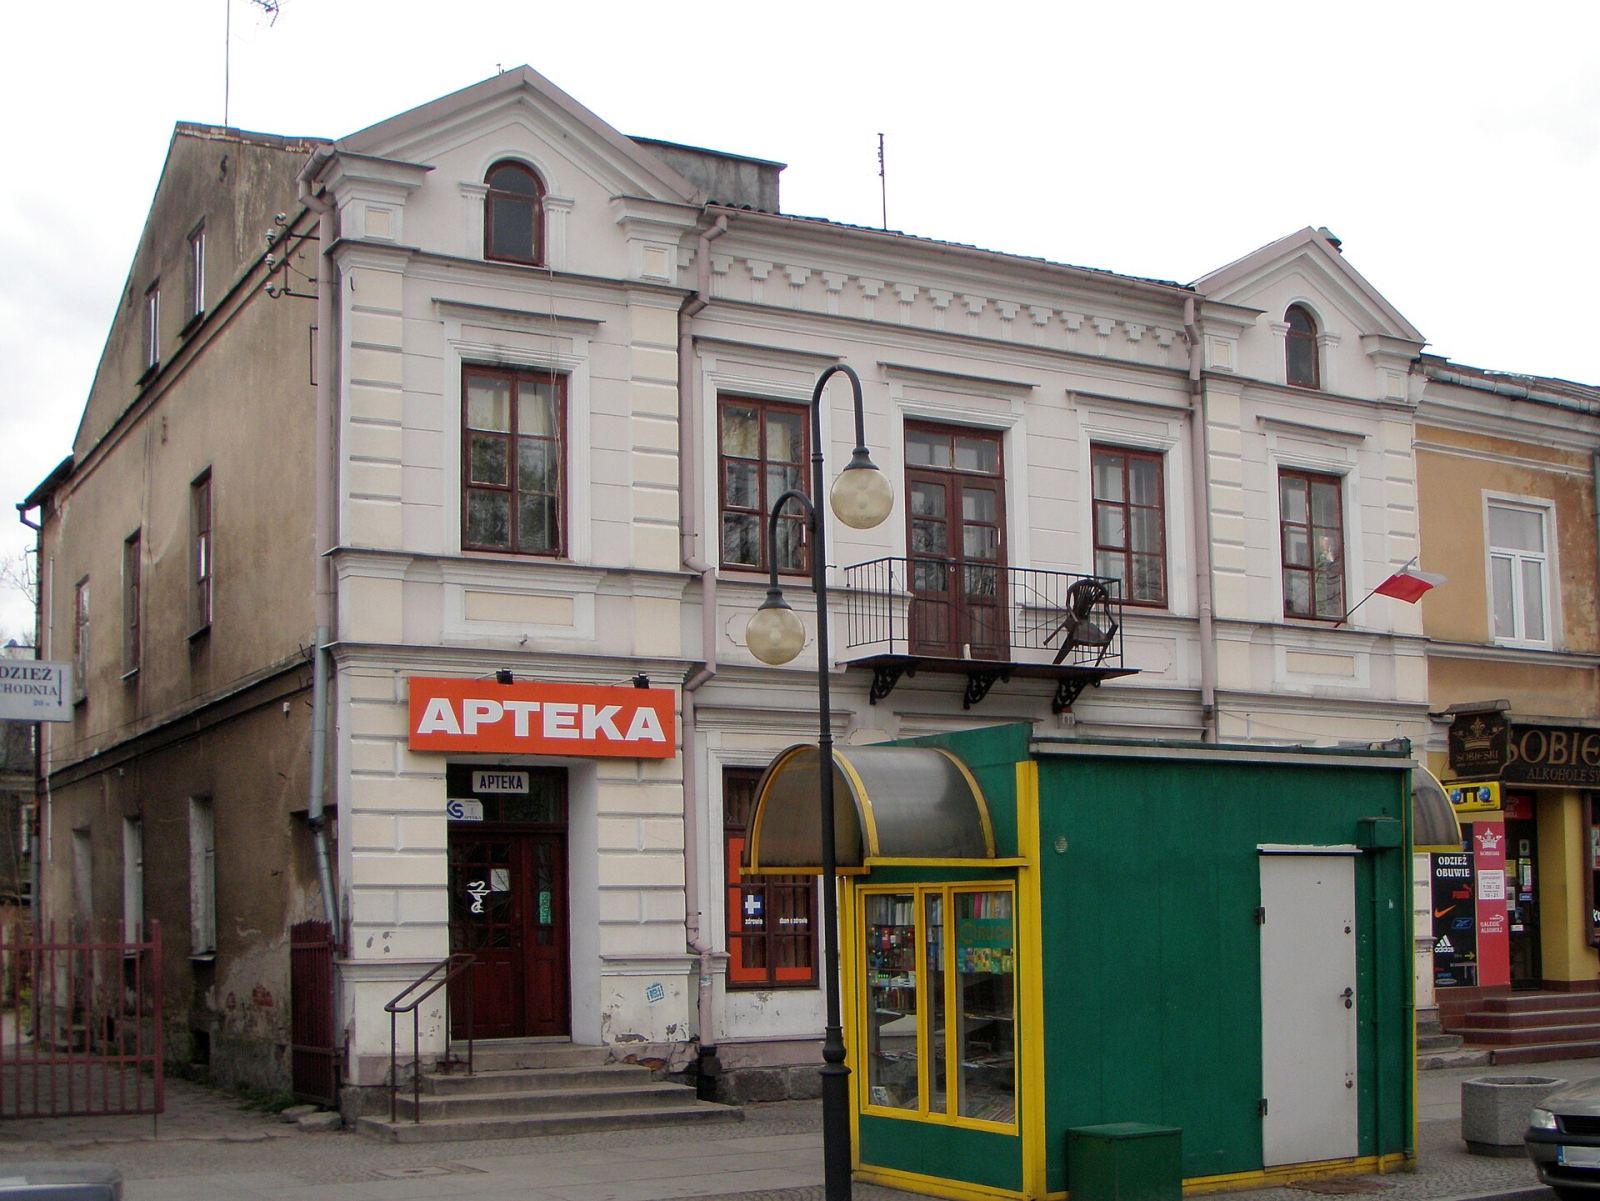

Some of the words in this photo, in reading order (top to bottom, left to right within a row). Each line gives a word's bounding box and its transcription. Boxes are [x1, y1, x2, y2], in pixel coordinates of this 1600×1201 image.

[0, 683, 57, 696] HODNIA
[416, 697, 667, 743] APTEKA
[1527, 766, 1586, 783] ALKOHOLE
[479, 774, 524, 790] APTEKA
[1438, 854, 1468, 866] ODZIEŻ
[1436, 868, 1471, 878] OBUWIE
